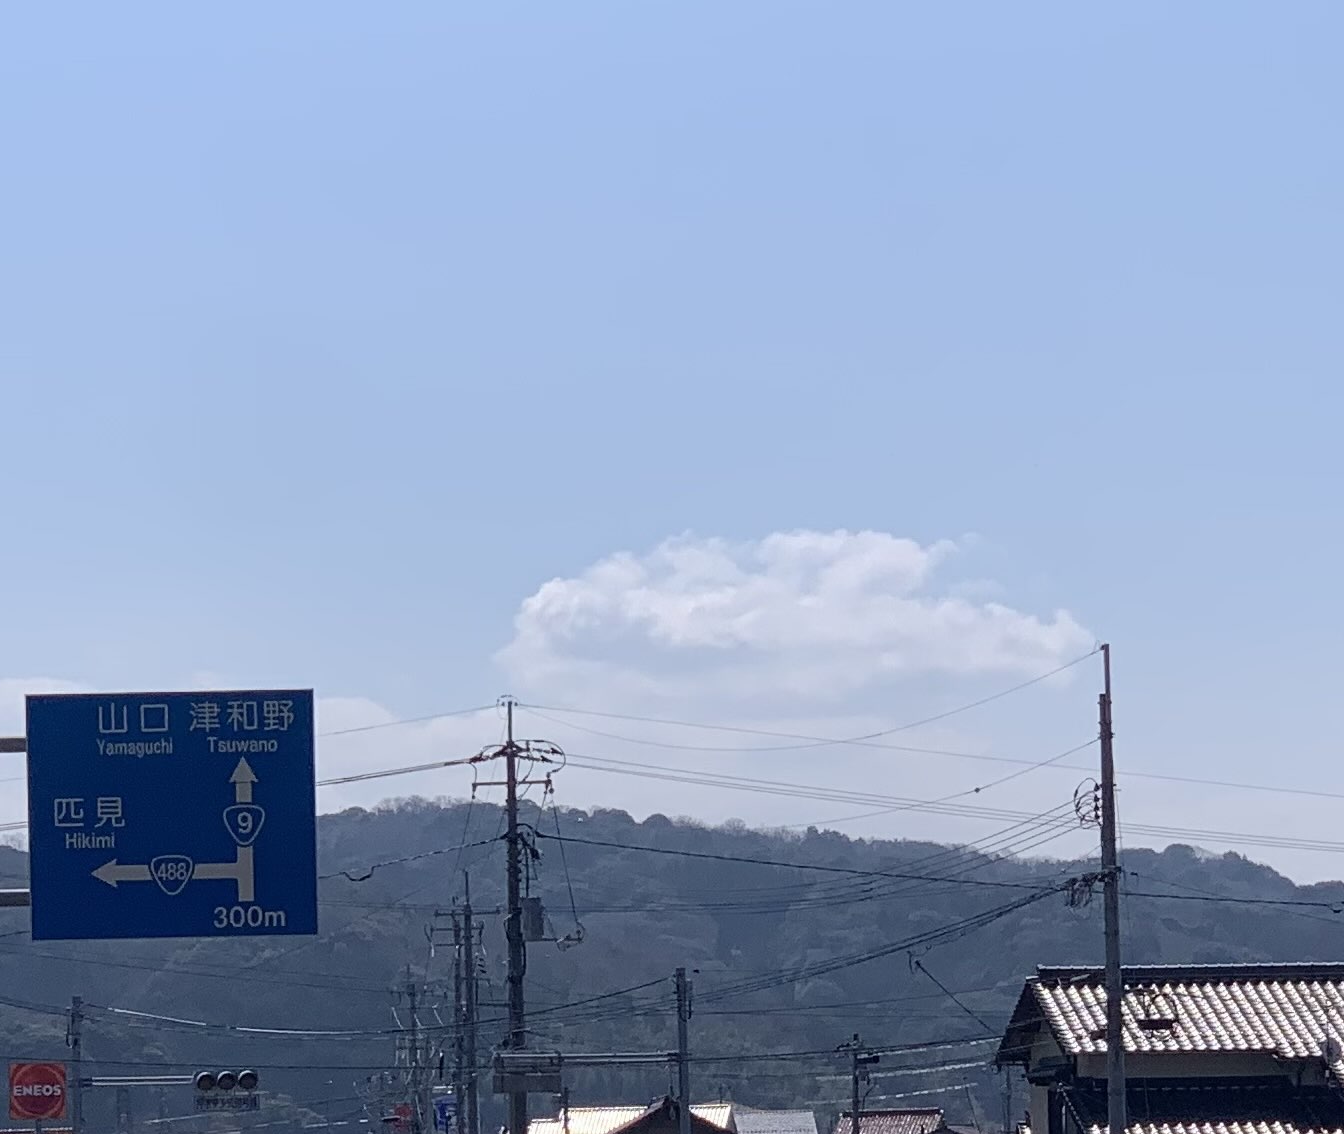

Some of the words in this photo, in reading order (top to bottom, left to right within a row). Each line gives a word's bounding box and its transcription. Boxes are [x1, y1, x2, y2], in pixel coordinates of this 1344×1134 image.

[97, 701, 169, 735] 山口
[189, 699, 295, 734] 津和野
[95, 737, 174, 759] Yamaguchi
[206, 736, 278, 754] Tsuwano
[53, 796, 126, 829] 匹見
[237, 811, 253, 835] 9
[64, 831, 116, 850] Hikimi
[156, 861, 188, 881] 488
[212, 905, 287, 929] 300m
[13, 1084, 62, 1097] ENEOS
